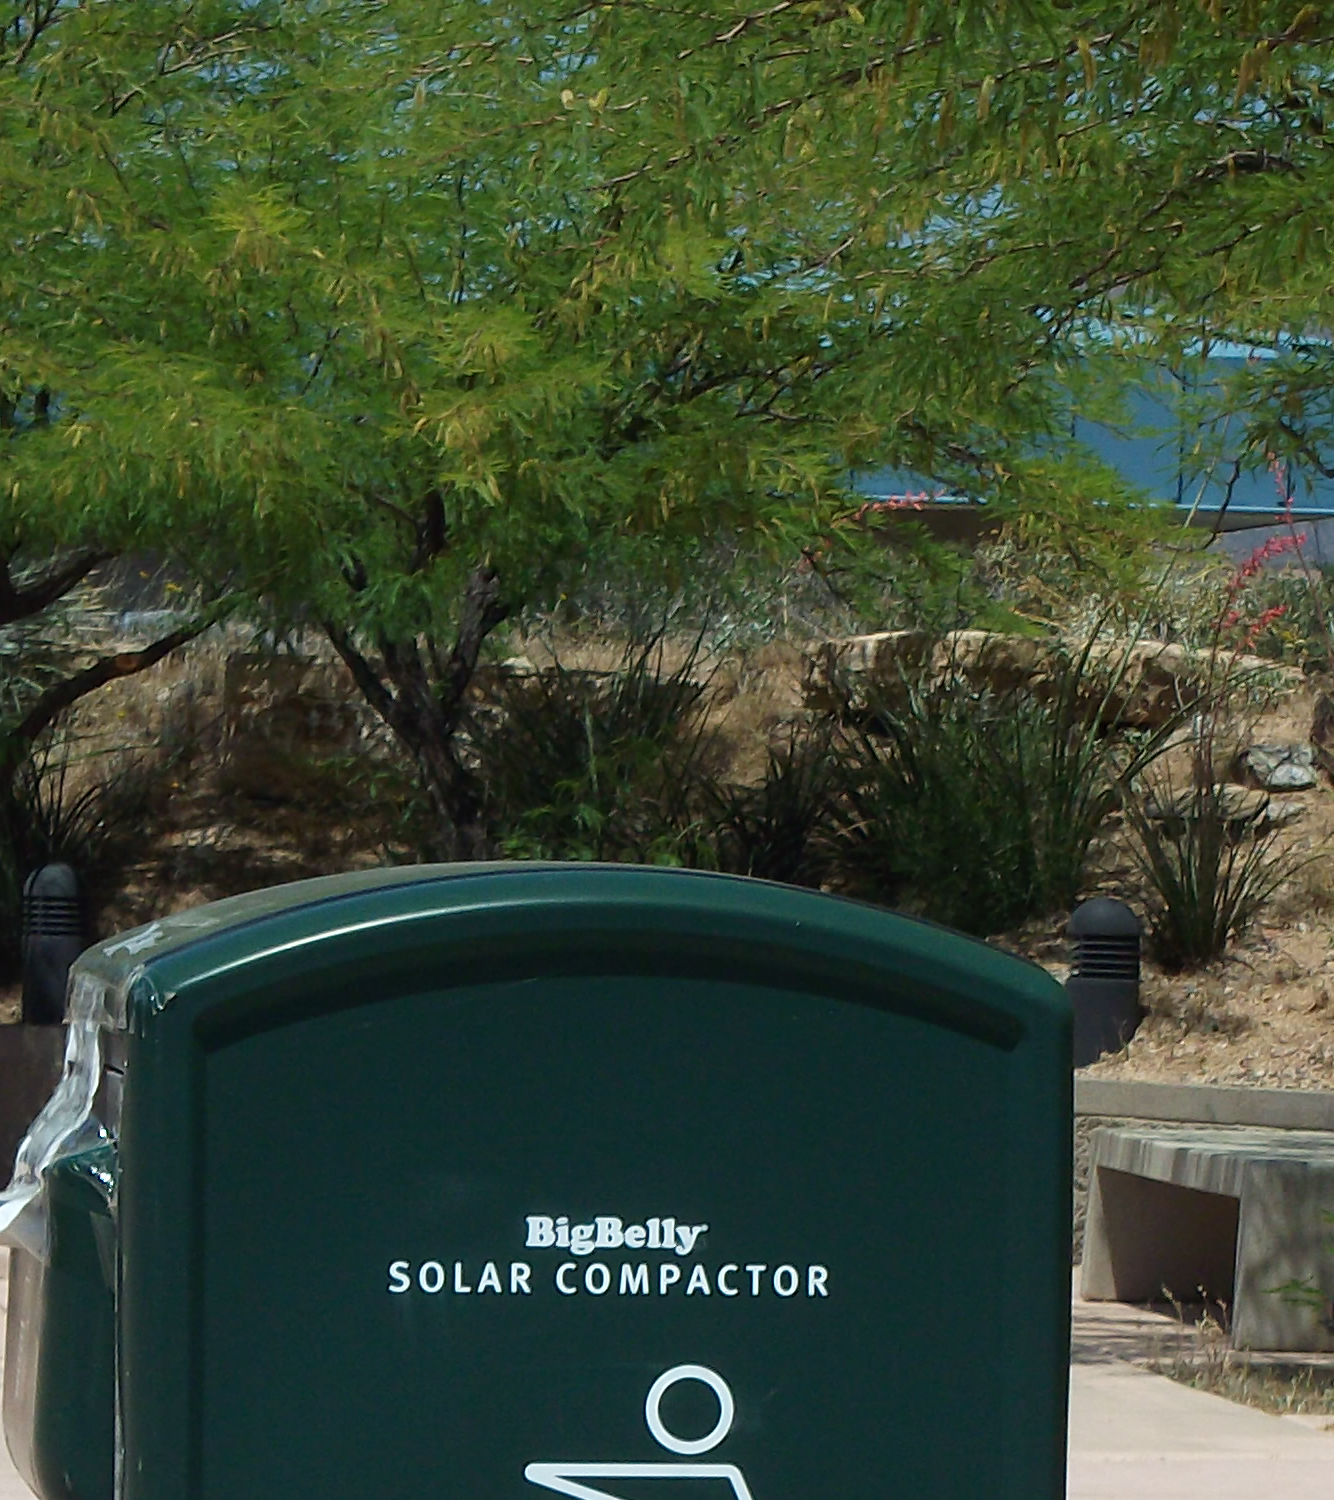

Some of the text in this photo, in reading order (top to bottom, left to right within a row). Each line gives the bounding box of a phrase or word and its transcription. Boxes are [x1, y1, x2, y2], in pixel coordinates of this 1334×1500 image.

[526, 1215, 709, 1256] BigBelly
[388, 1260, 829, 1297] SOLAR COMPACTOR
